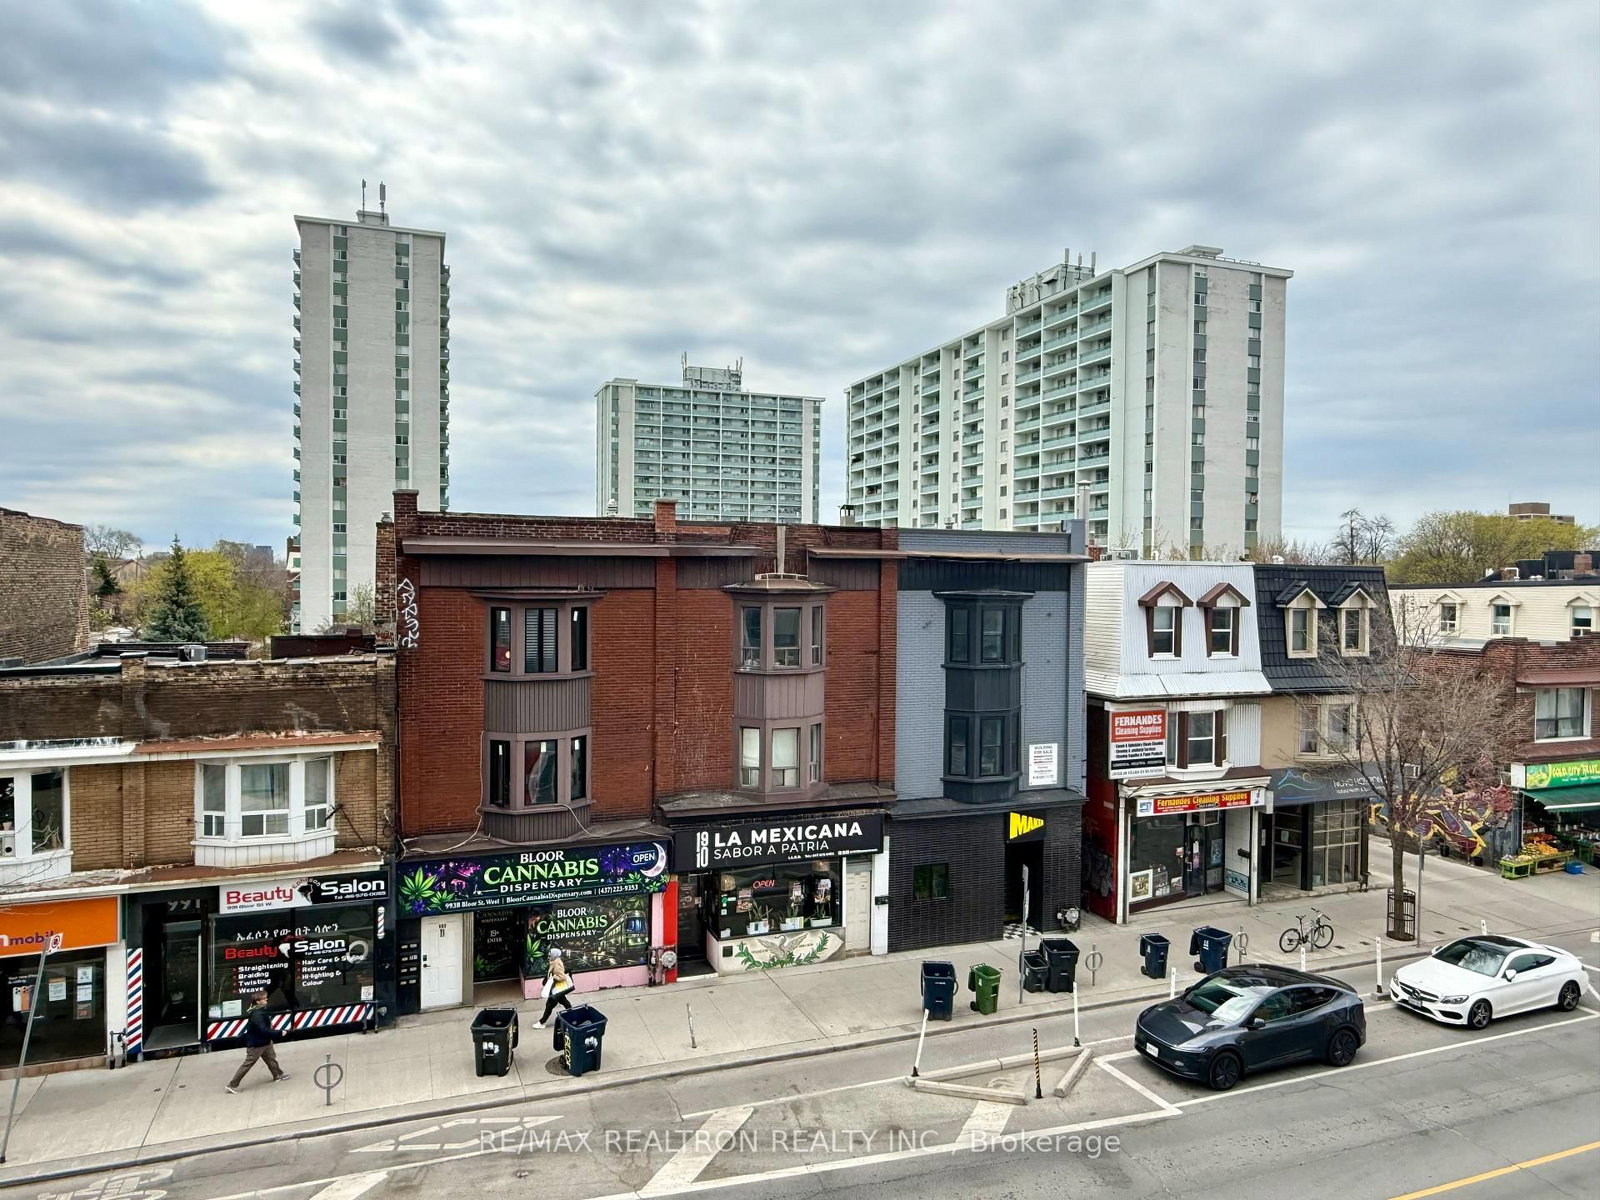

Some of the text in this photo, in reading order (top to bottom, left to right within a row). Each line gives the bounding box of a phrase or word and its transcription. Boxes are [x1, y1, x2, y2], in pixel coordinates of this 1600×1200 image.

[1115, 714, 1162, 727] FERNANDES
[1115, 725, 1162, 736] Cleaning Supplies
[1157, 797, 1191, 807] Fernandes
[1192, 793, 1220, 803] Cleaning
[1221, 792, 1248, 801] Supplies
[714, 821, 863, 848] LA MEXICANA
[714, 845, 762, 860] SABOR
[767, 844, 777, 855] A
[781, 840, 829, 854] PATRIA
[520, 850, 565, 864] BLOOR
[633, 852, 656, 863] OPEN
[483, 857, 600, 885] CANNABIS
[500, 877, 584, 893] DISPENSARY
[752, 879, 775, 889] OPEN
[226, 878, 385, 905] Beauty Salon
[506, 889, 592, 903] BloorCannabisDispensary.com
[557, 906, 588, 918] BLOOR
[536, 914, 608, 934] CANNABIS
[547, 929, 597, 940] DISPENSARY
[224, 944, 278, 960] Beauty
[294, 938, 346, 953] Salon
[238, 962, 289, 973] Straightening
[302, 965, 327, 973] Relaxer
[238, 971, 270, 980] Braiding
[238, 977, 272, 987] Twisting
[302, 979, 324, 987] Colour
[238, 986, 264, 994] Weave
